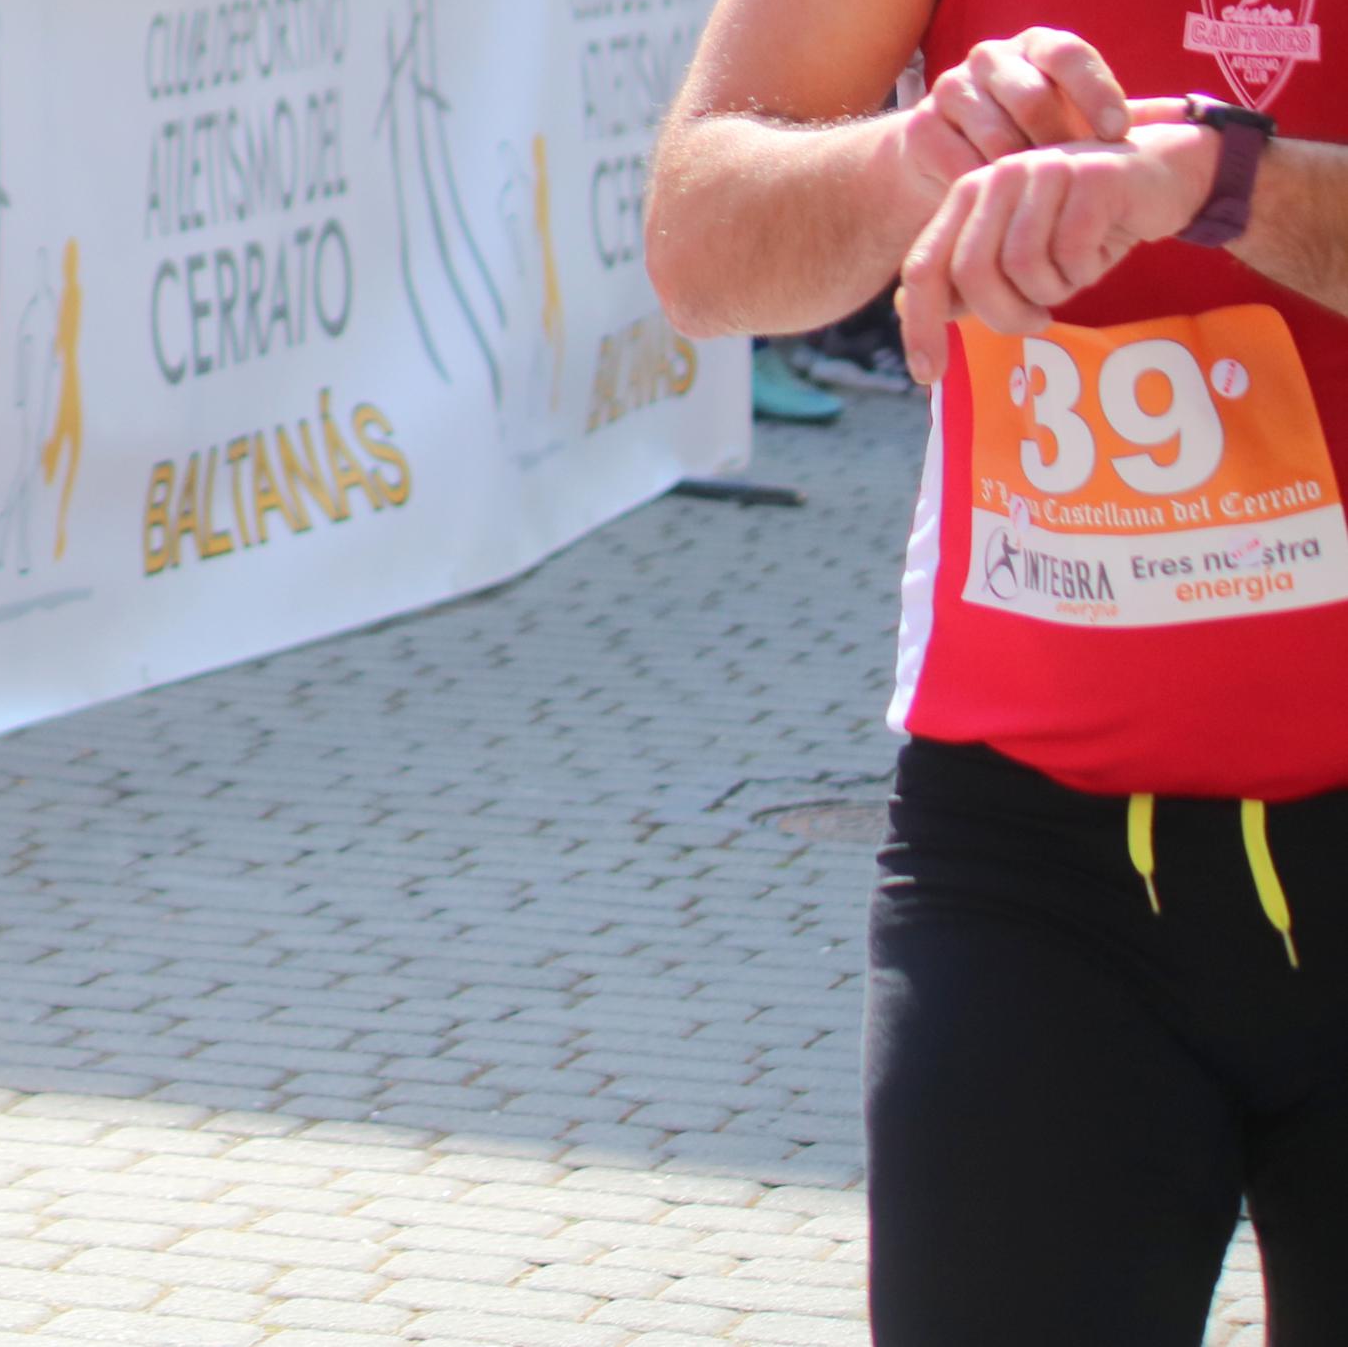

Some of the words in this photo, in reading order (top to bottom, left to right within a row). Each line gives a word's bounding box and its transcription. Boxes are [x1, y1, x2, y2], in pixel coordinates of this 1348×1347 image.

[144, 6, 208, 101] CLUB
[1192, 21, 1312, 53] CANTONES
[143, 97, 298, 241] ATLETISMO
[151, 218, 353, 386] CERRATO
[1019, 336, 1225, 496] 39
[142, 386, 413, 578] BALTANÁS
[1044, 498, 1165, 528] Castellana
[1171, 498, 1210, 524] del
[1220, 479, 1322, 517] Cerrato
[1023, 547, 1115, 601] INTEGRA
[1131, 554, 1194, 580] Eres
[1176, 565, 1295, 603] energía
